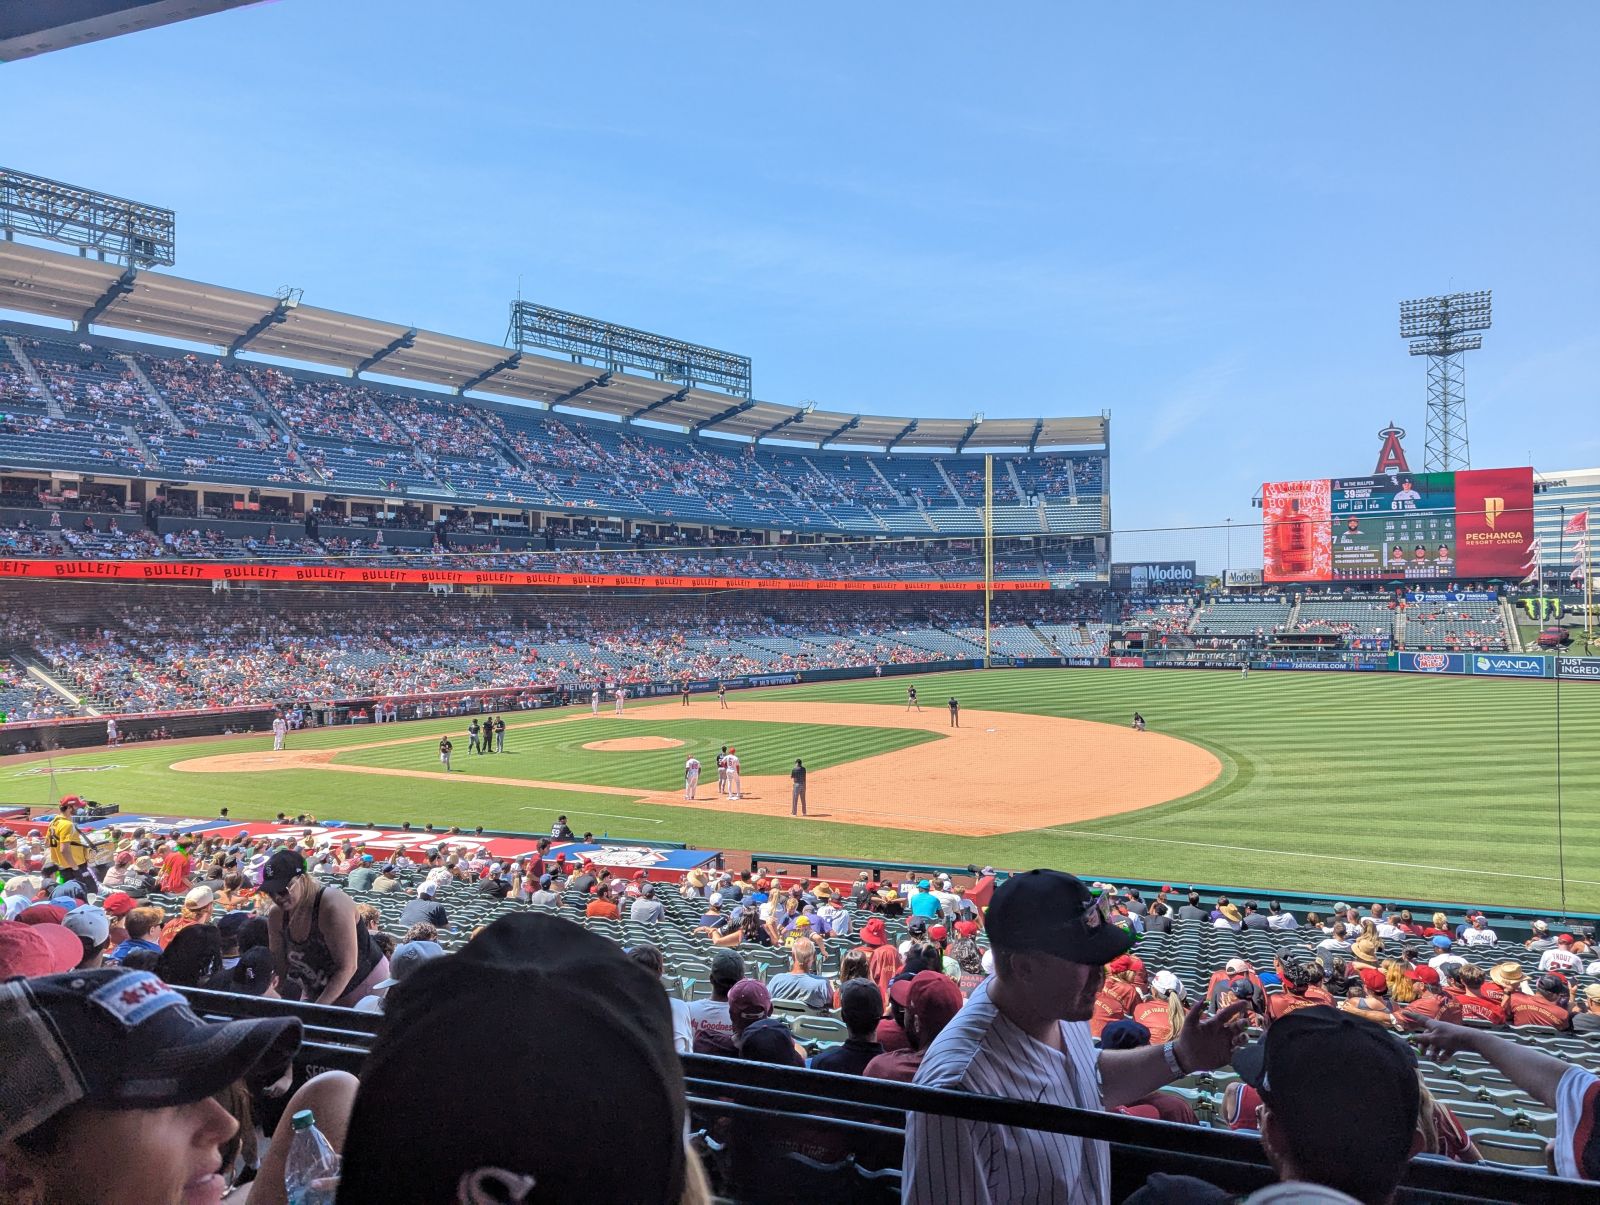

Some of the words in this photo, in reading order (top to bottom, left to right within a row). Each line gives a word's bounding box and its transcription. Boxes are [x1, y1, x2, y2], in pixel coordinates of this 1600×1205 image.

[1344, 490, 1355, 499] 39
[1392, 501, 1402, 510] 61
[1466, 532, 1522, 540] PECHANGA
[56, 562, 122, 576] BULLEIT
[143, 566, 204, 578] BULLEIT
[224, 568, 278, 579] BULLEIT
[296, 569, 346, 580] BULLEIT
[362, 571, 406, 581] BULLEIT
[421, 572, 462, 582] BULLEIT
[476, 573, 514, 583] BULLEIT
[526, 575, 561, 584] BULLEIT
[572, 576, 605, 585] BULLEIT
[1148, 565, 1192, 580] Modelo
[1230, 572, 1256, 582] Modelo
[1492, 660, 1540, 669] VANDA
[551, 829, 560, 838] 59
[1552, 953, 1571, 961] TROUT
